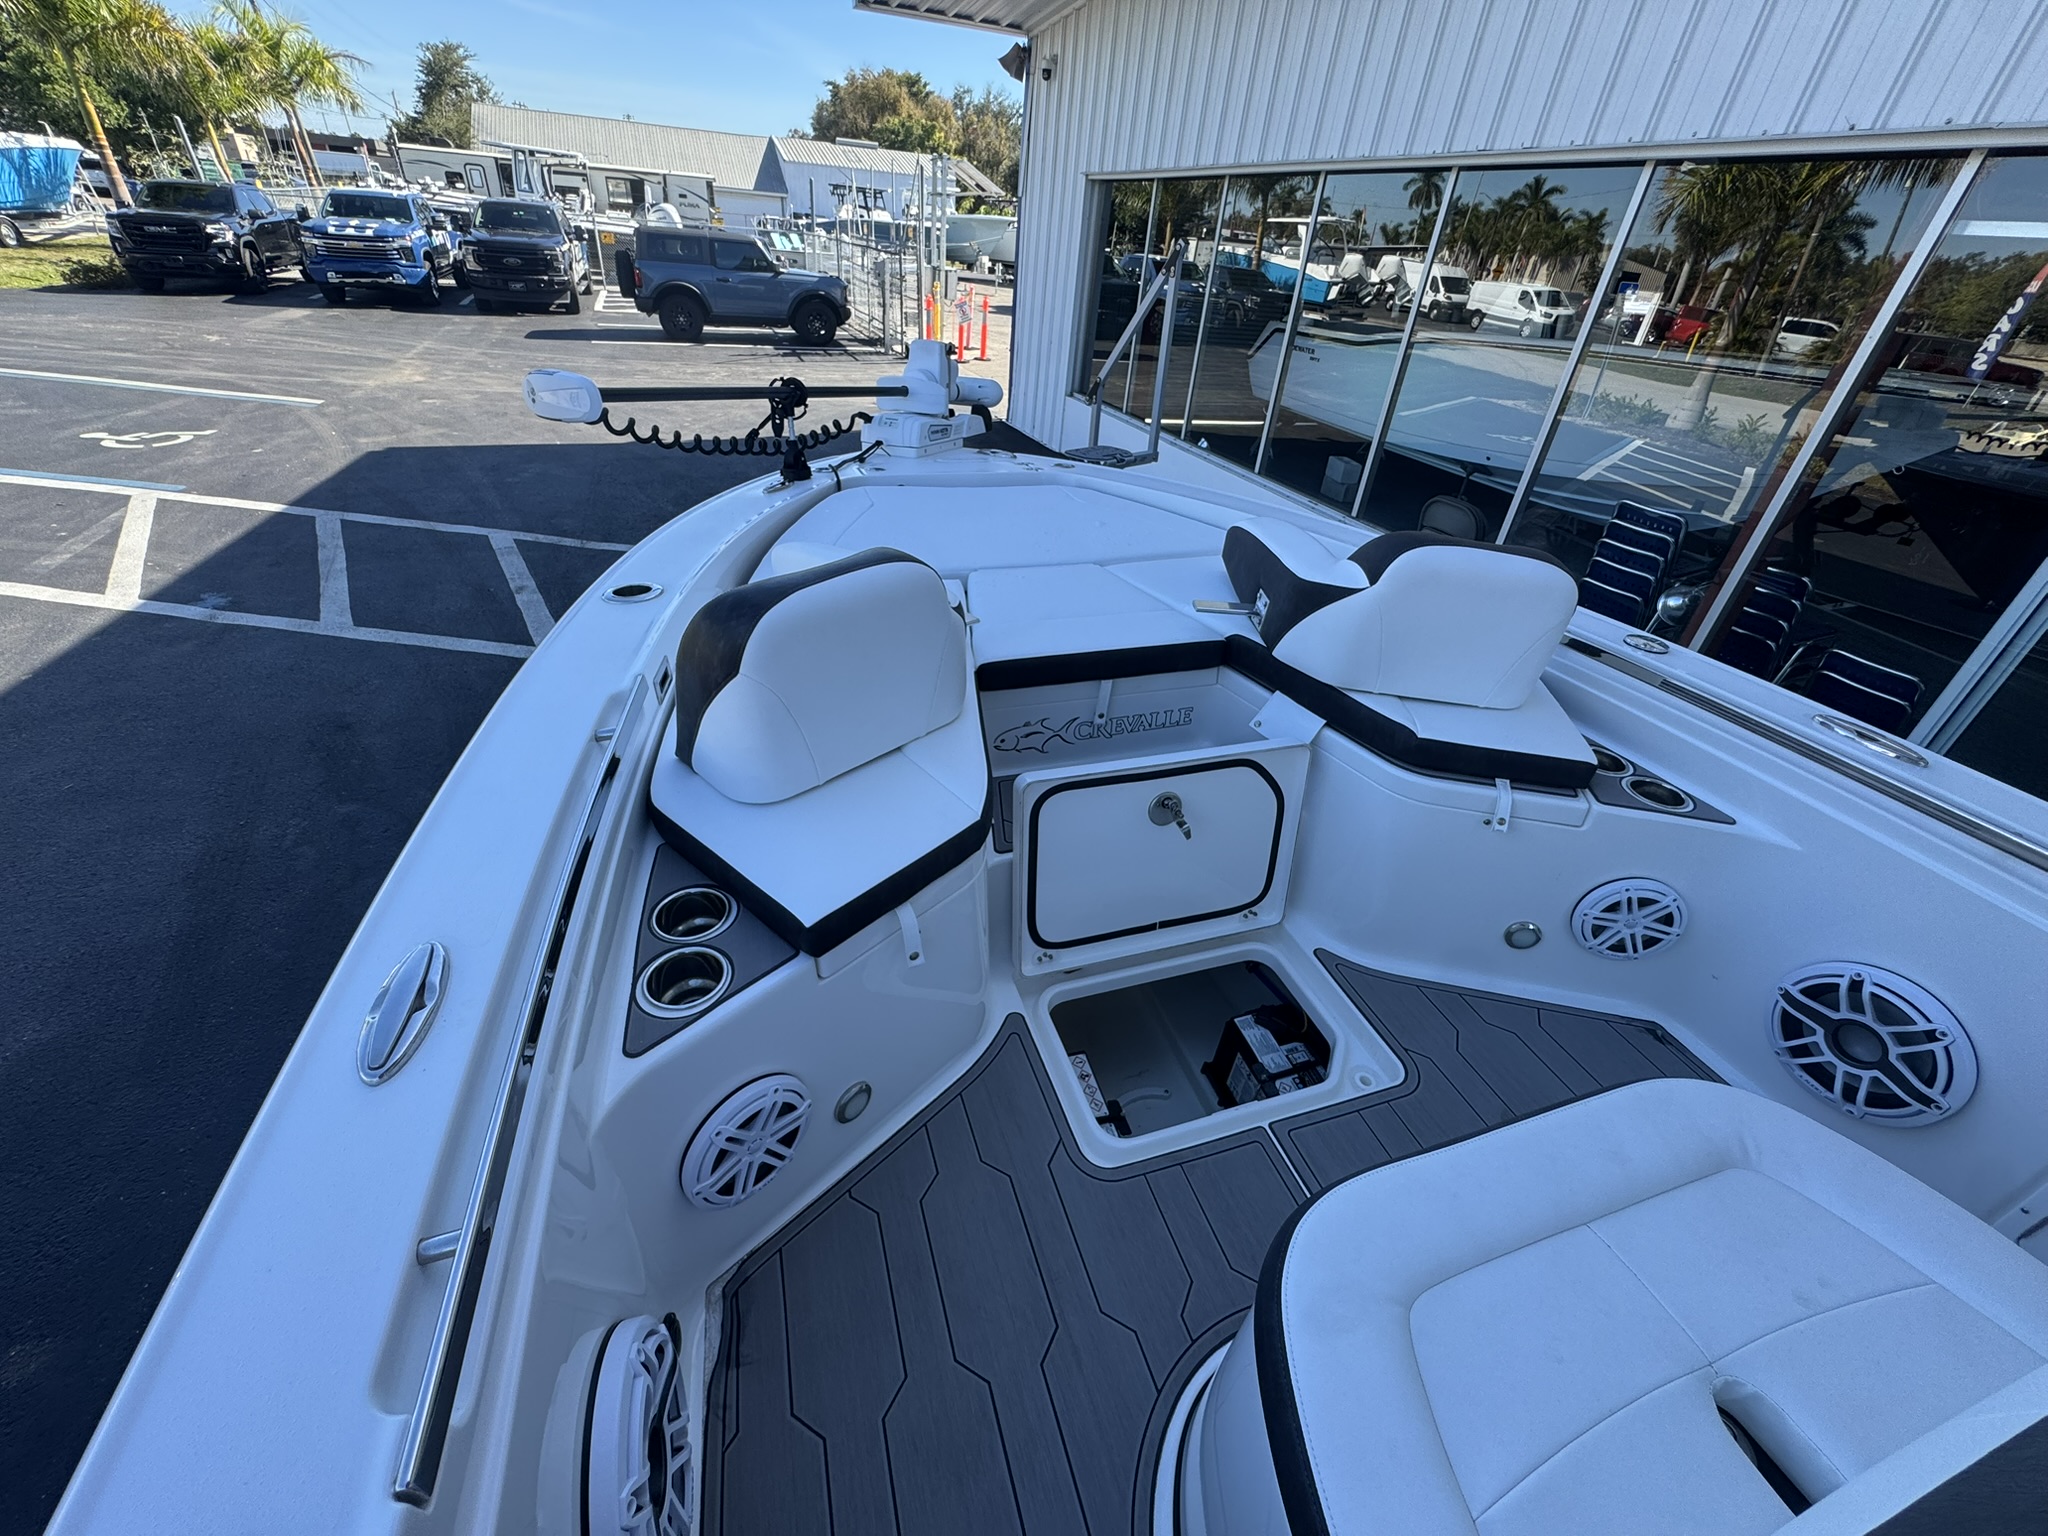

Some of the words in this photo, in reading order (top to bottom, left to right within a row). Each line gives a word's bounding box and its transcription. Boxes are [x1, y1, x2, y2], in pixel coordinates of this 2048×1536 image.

[679, 201, 701, 209] PUMA
[143, 225, 177, 234] GMC
[1073, 707, 1194, 741] CREVALLE
